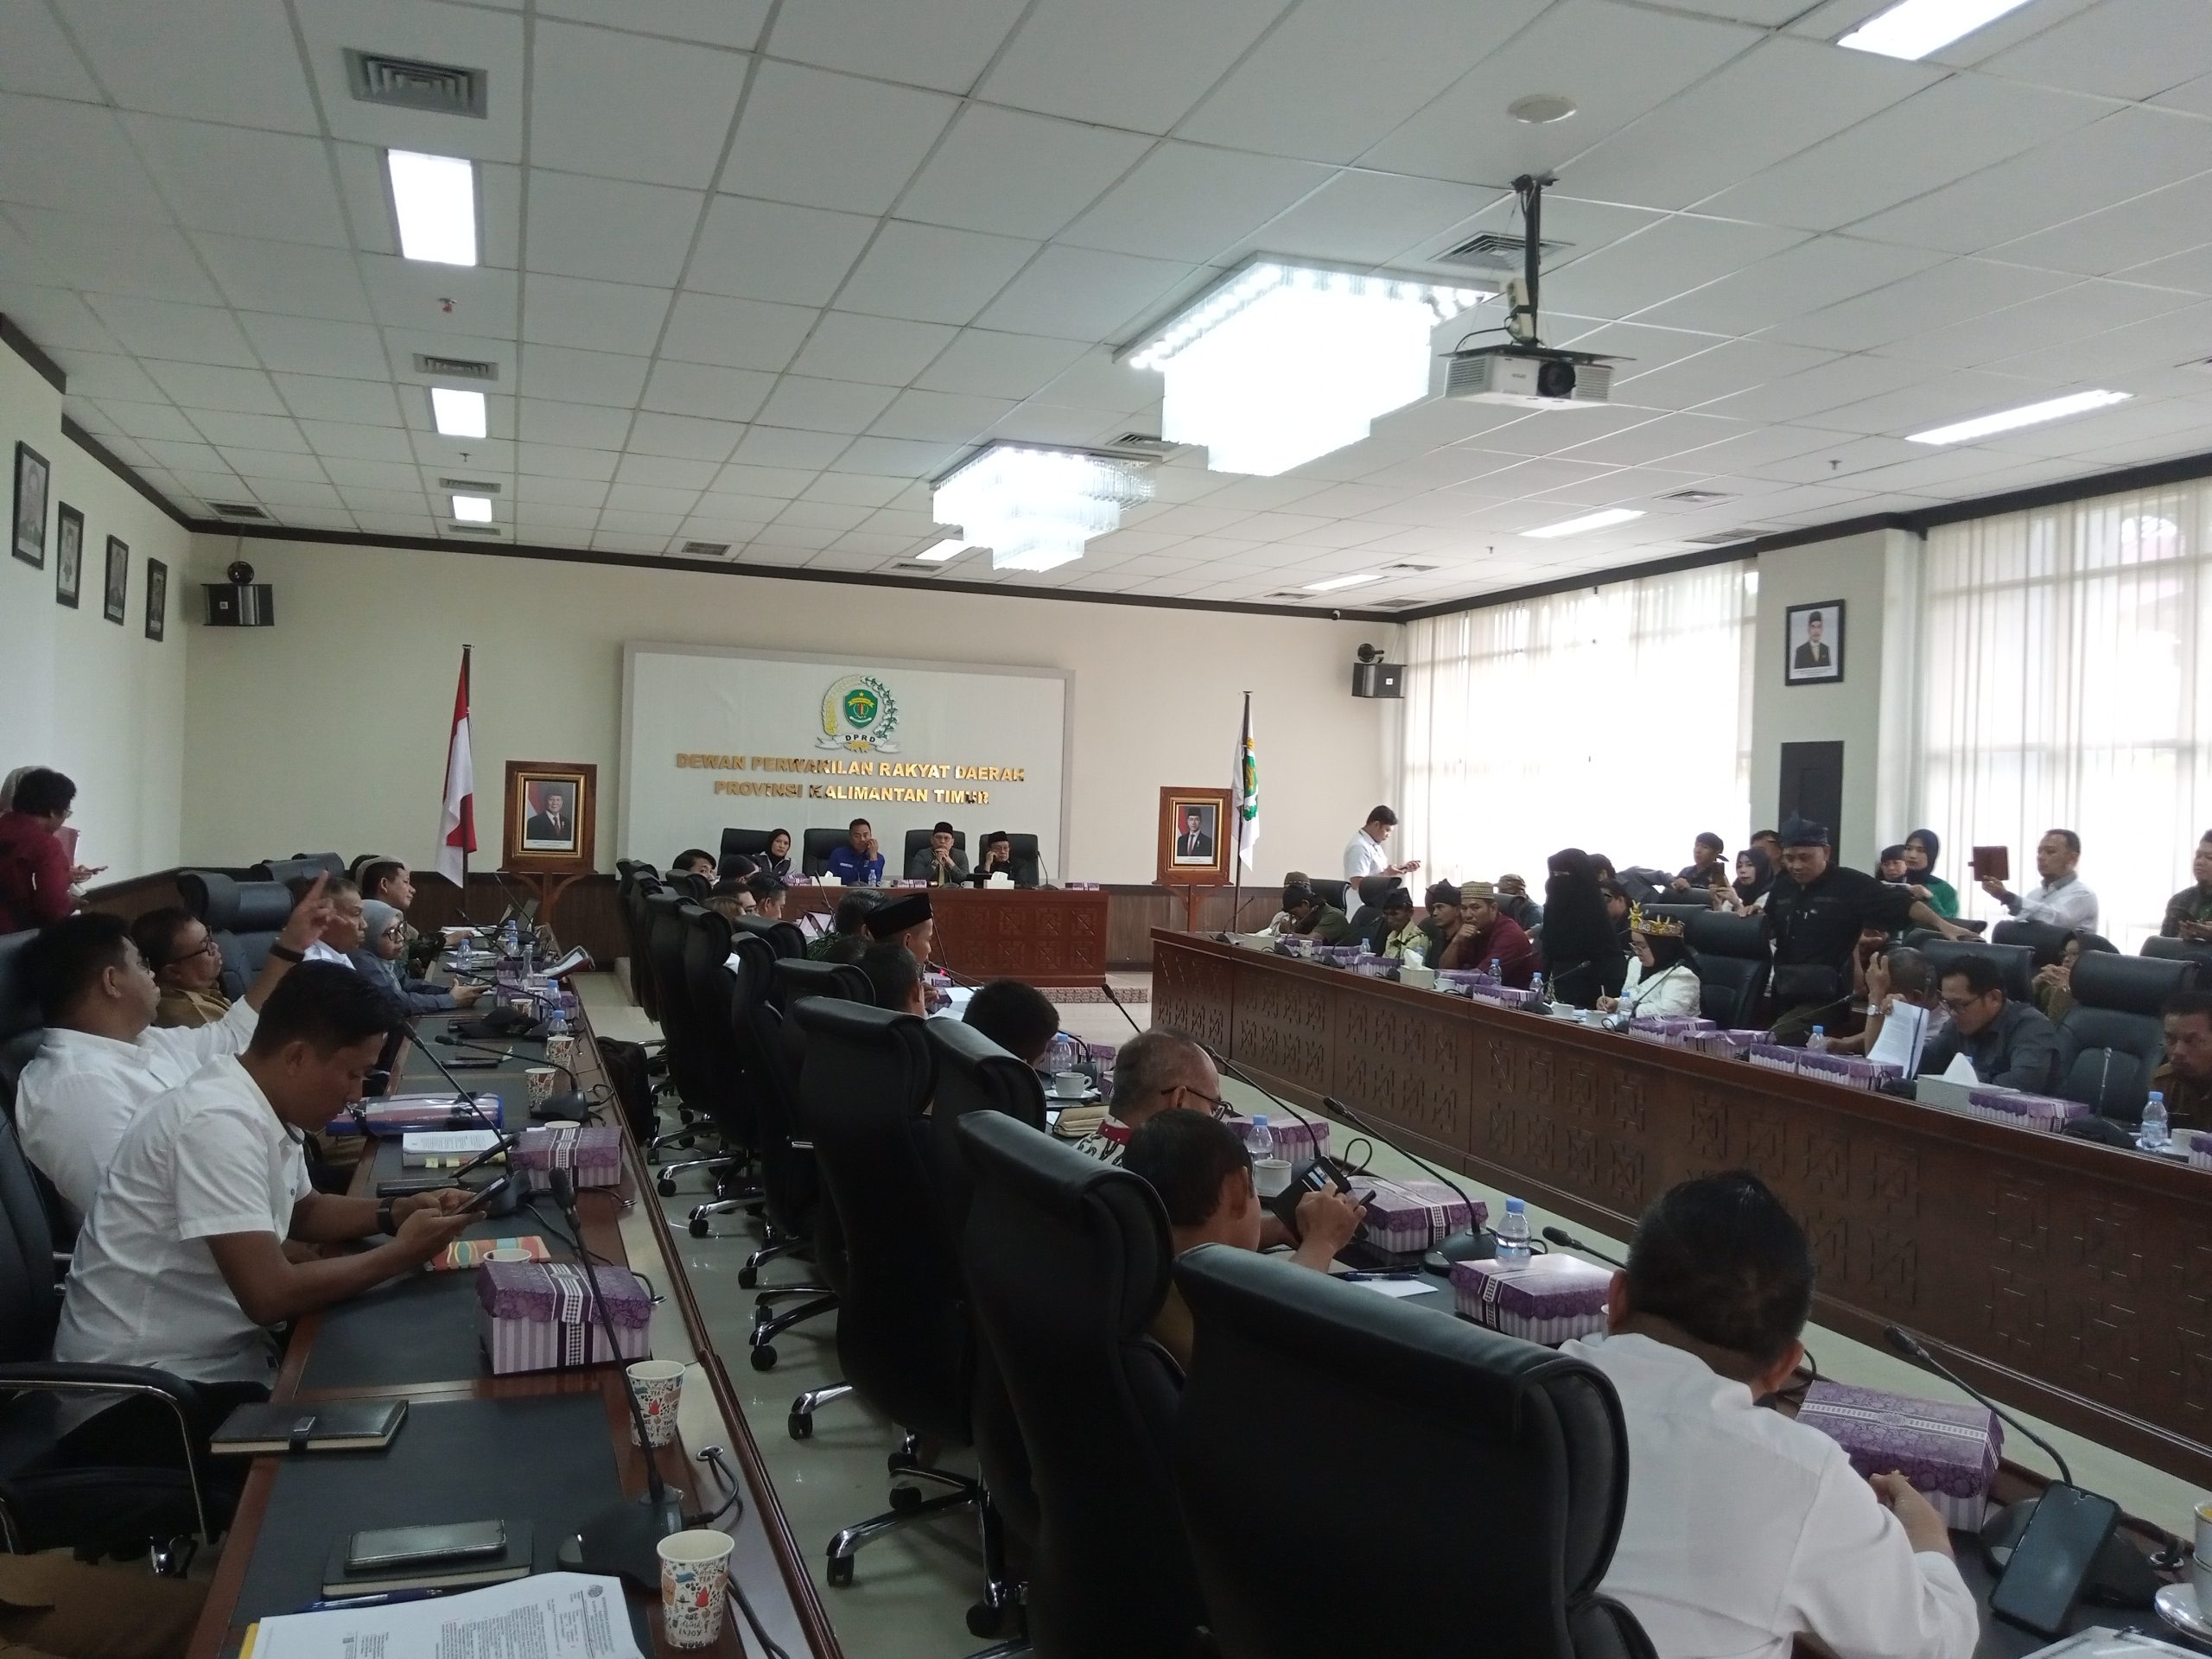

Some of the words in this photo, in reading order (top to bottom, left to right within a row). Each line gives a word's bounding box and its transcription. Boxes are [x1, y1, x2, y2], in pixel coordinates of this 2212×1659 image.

[677, 753, 747, 770] DEWAN
[751, 756, 874, 775] PERWAKILAN
[879, 762, 950, 779] RAKYAT
[955, 765, 1025, 781] DAERAH
[714, 780, 803, 798] PROVINSI
[809, 785, 928, 803] KALIMANTAN
[933, 789, 989, 804] TIMUR
